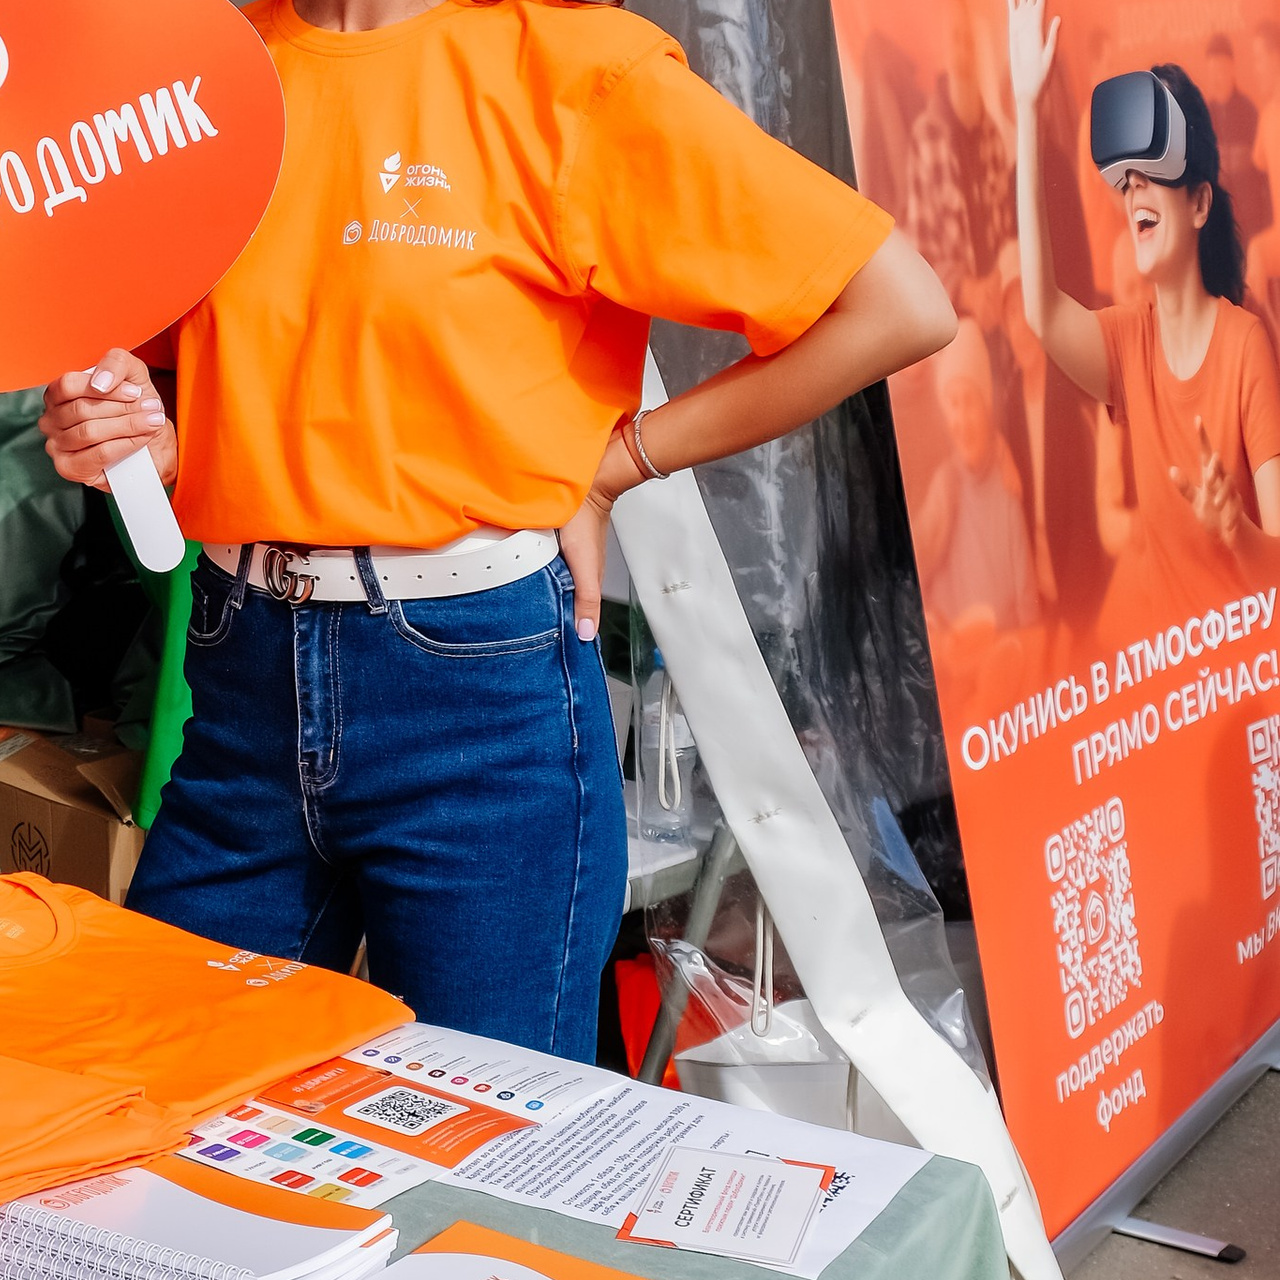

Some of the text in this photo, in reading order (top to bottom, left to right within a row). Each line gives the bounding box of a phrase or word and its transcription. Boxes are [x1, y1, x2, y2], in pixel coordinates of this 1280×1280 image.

[404, 176, 452, 193] ЖИЗНИ
[406, 164, 448, 180] ОГОНЬ
[367, 219, 478, 251] ДОБРОДОМИК
[961, 586, 1278, 771] ОКУНИСЬ В АТМОСФЕРУ
[1071, 649, 1280, 787] ПРЯМО СЕЙЧАС!
[1237, 928, 1266, 965] мы
[1056, 998, 1165, 1104] поддержать
[1096, 1069, 1148, 1133] фонд
[672, 1166, 717, 1228] СЕРТИФИКАТ
